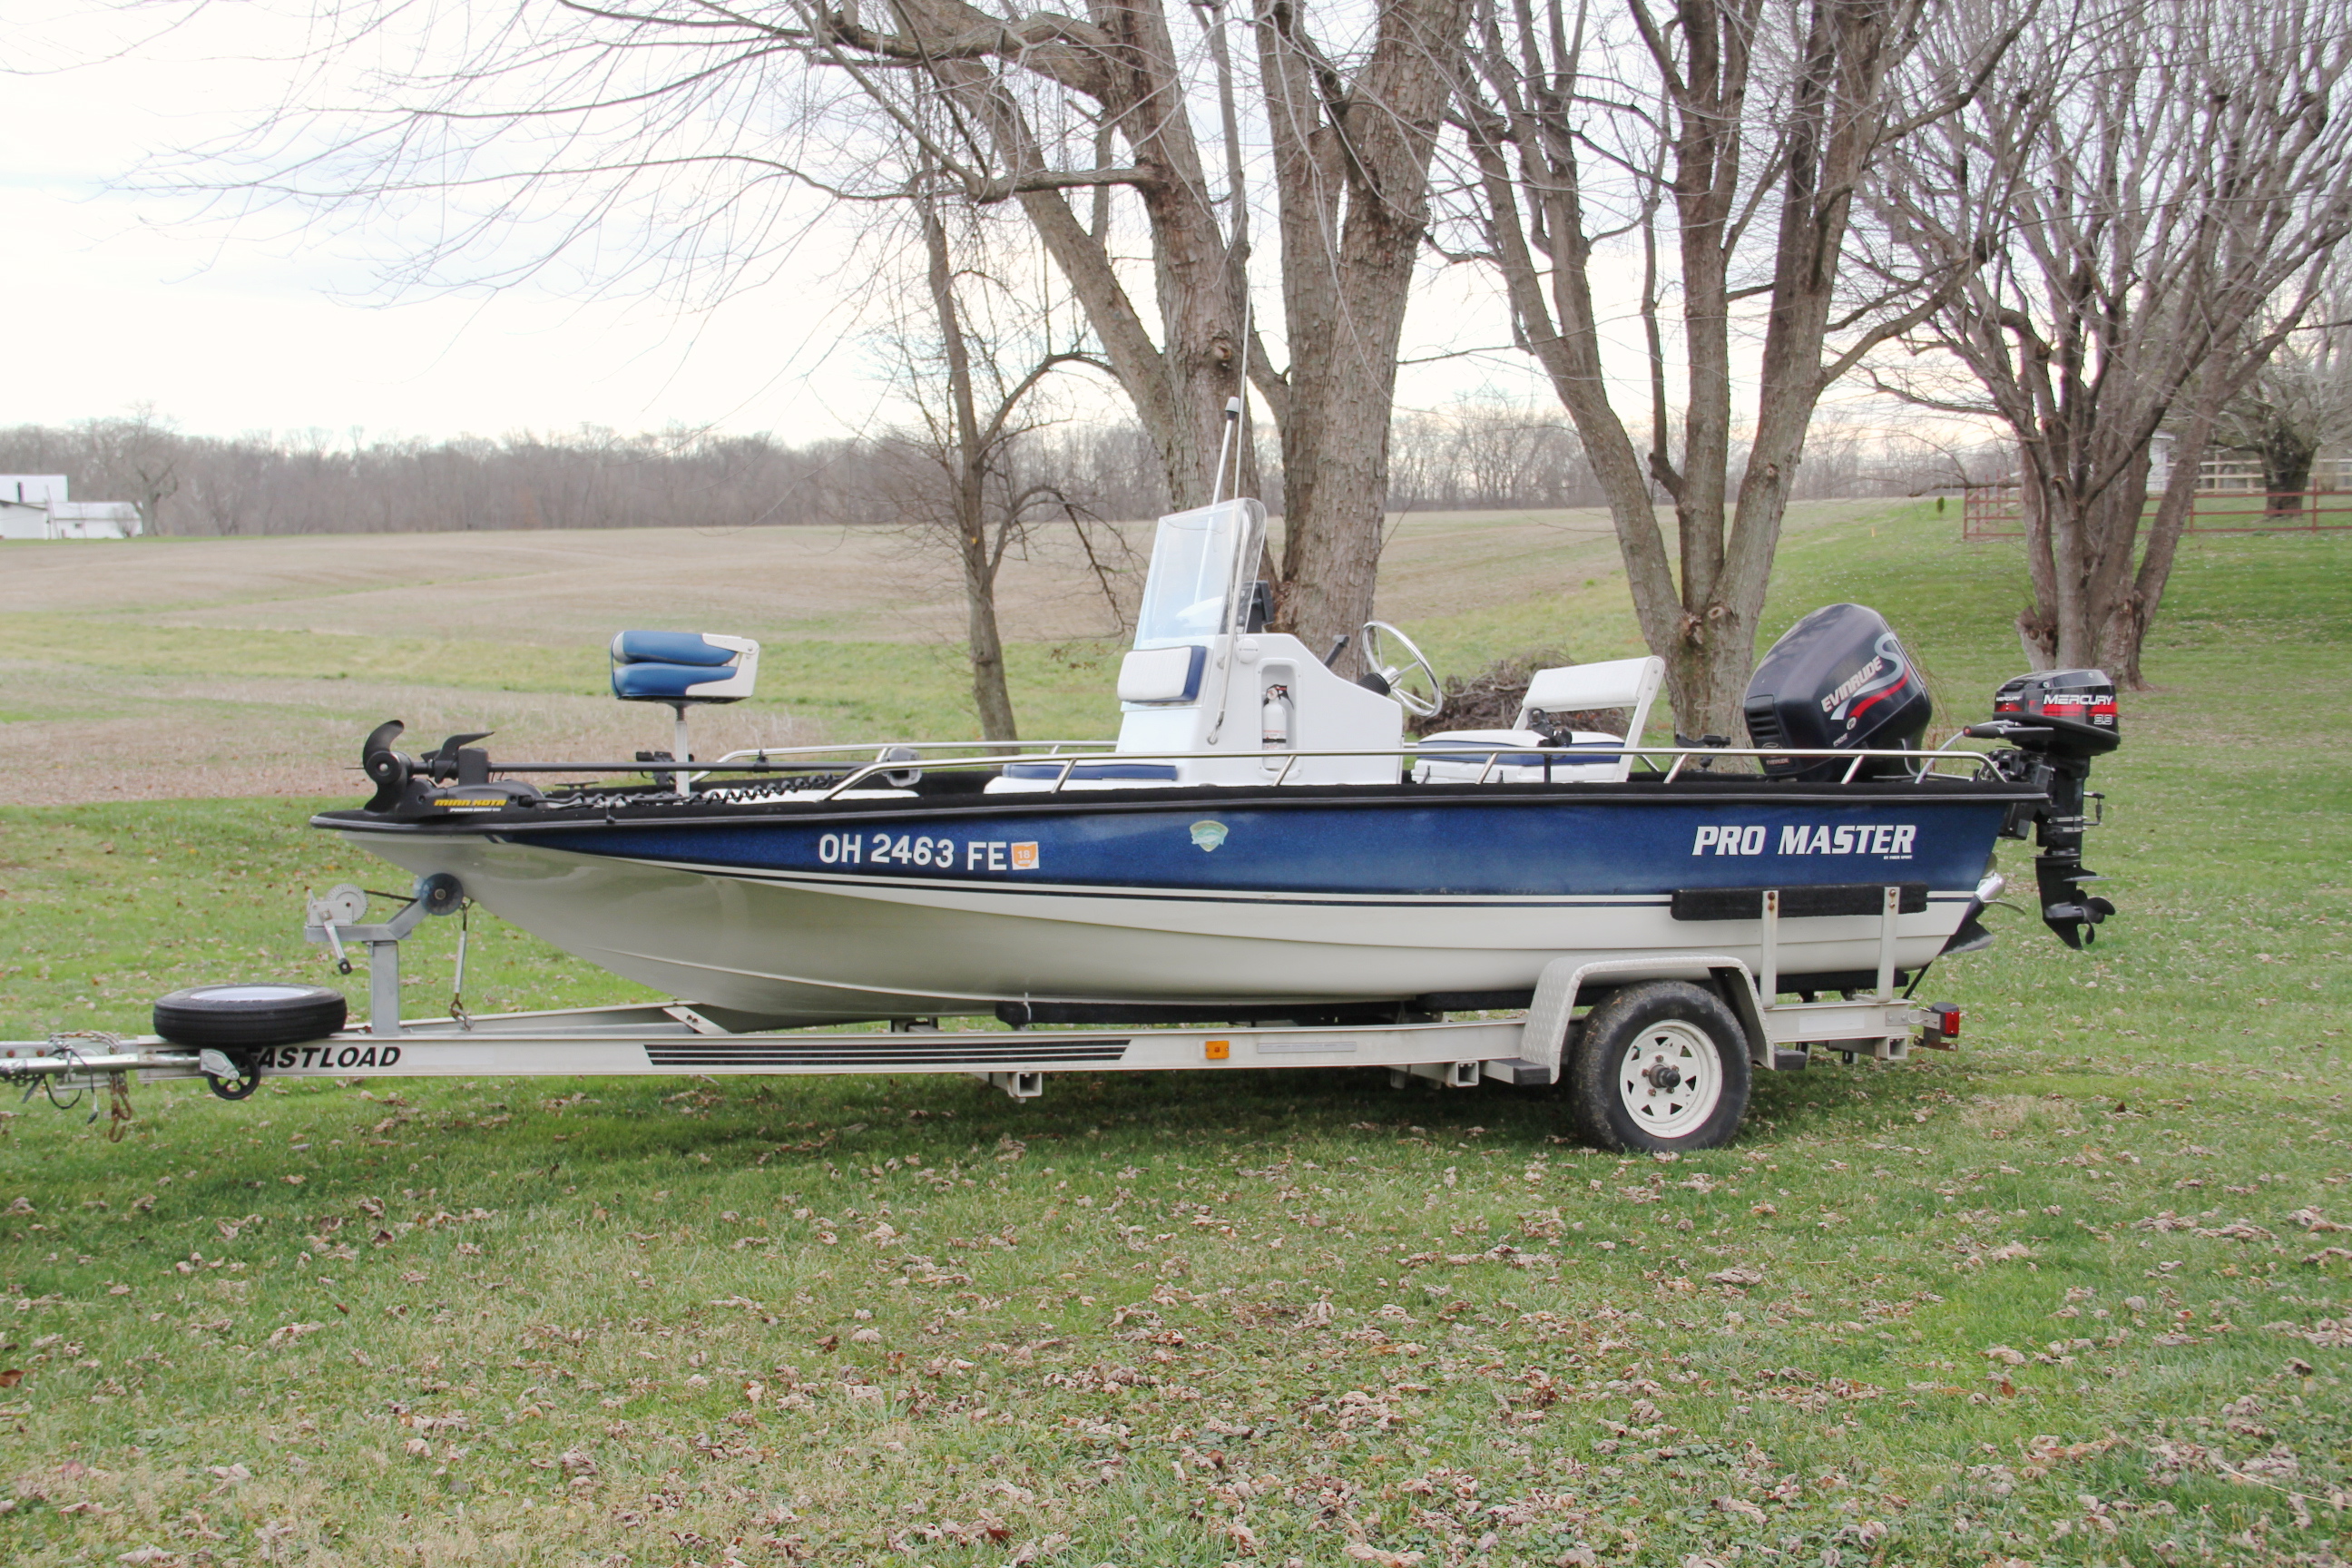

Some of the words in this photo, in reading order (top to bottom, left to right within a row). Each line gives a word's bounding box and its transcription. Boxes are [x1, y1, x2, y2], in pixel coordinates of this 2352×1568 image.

[1820, 655, 1884, 713] EVINRUDE
[2043, 694, 2114, 706] MERCURY
[818, 833, 862, 864] OH
[870, 833, 955, 868] 2463
[967, 841, 1007, 871] FE
[1016, 849, 1031, 859] 18
[1691, 825, 1767, 856] PRO
[1777, 824, 1917, 855] MASTER
